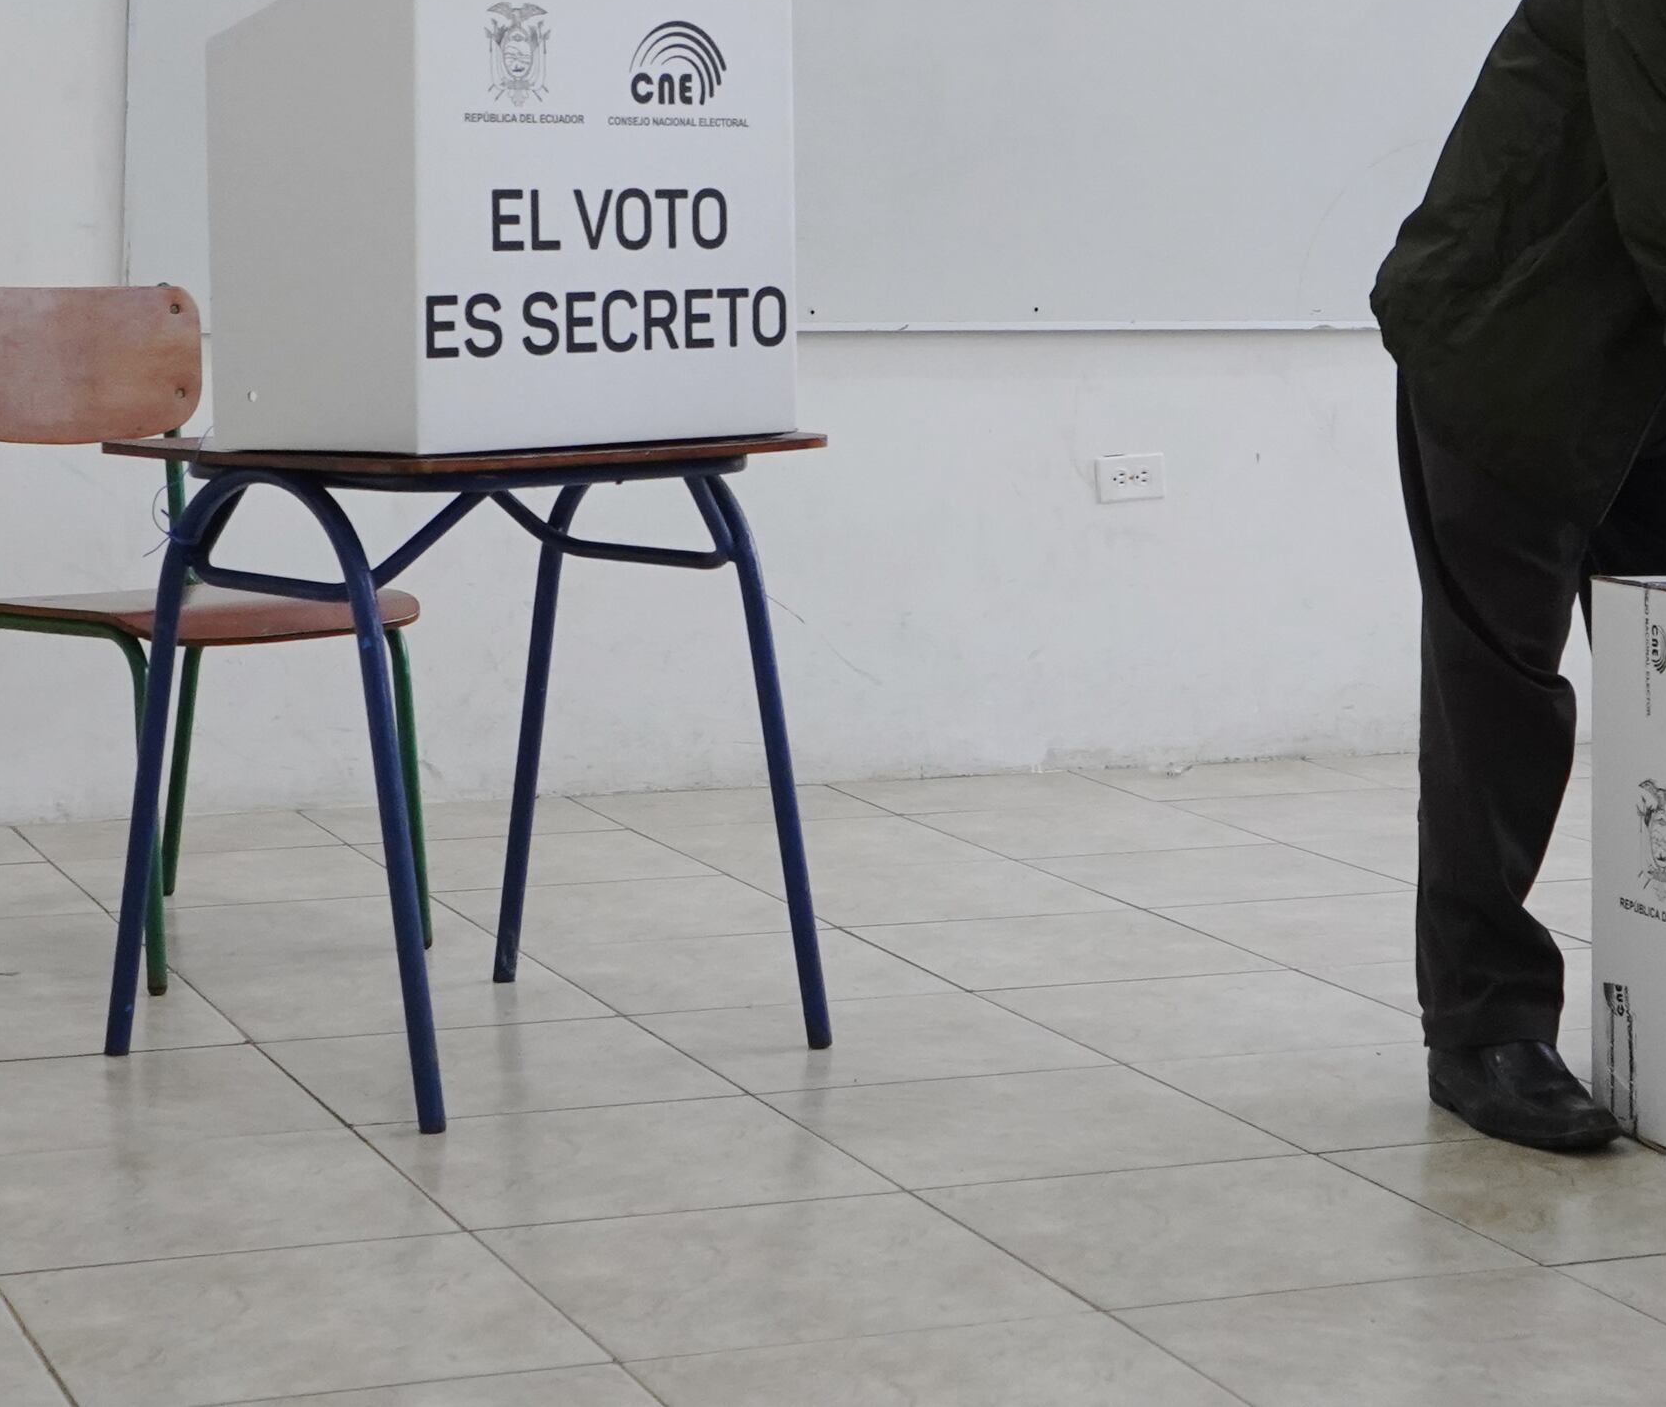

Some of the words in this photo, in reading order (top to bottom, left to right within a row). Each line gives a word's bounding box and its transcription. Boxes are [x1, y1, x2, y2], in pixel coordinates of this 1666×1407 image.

[630, 72, 694, 105] CNE
[464, 112, 517, 124] REPÚBLICA
[519, 113, 537, 124] DEL
[540, 114, 585, 125] ECUADOR
[608, 116, 650, 127] CONSEJO
[653, 117, 697, 128] NACIONAL
[699, 117, 749, 128] ELECTORAL
[491, 188, 561, 252] EL
[573, 187, 728, 251] VOTO
[426, 293, 503, 359] ES
[522, 286, 787, 356] SECRETO
[1651, 624, 1659, 657] CNE
[1620, 896, 1661, 922] REPÚBLICA
